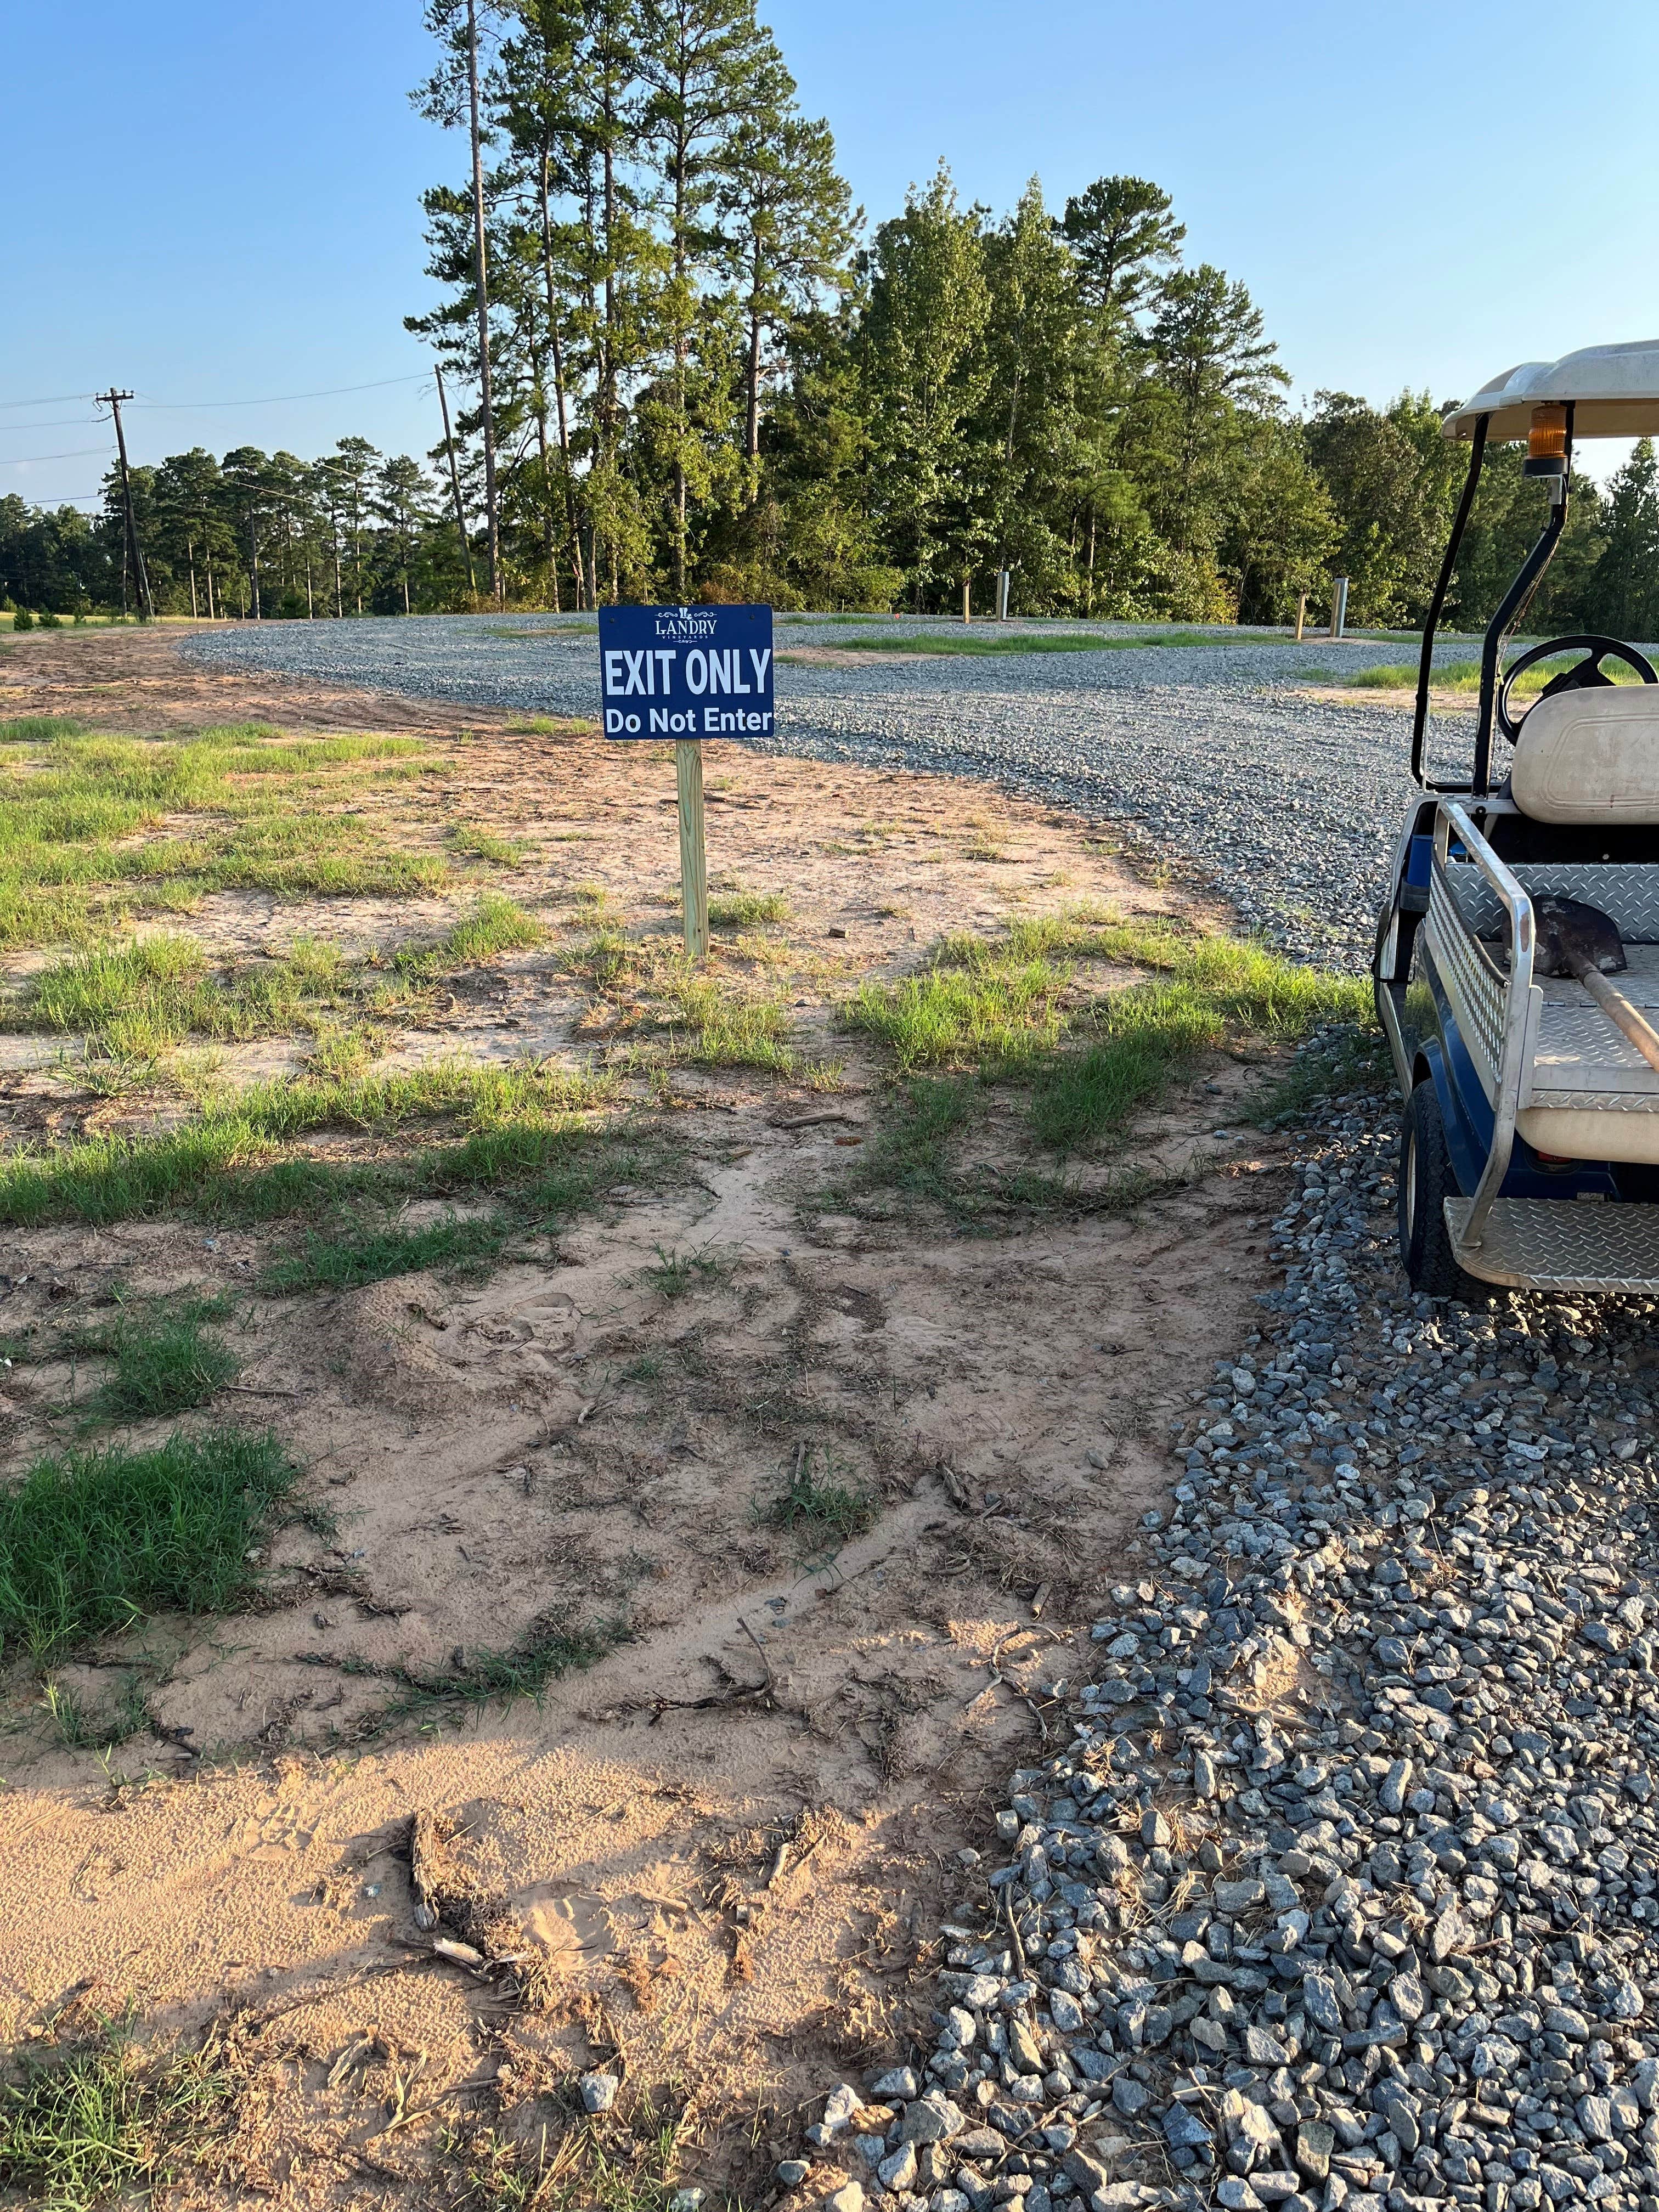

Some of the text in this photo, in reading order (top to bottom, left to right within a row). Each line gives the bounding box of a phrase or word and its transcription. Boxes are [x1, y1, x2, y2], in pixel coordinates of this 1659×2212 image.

[655, 620, 717, 635] LANDRY
[605, 649, 771, 695] EXIT ONLY
[606, 707, 772, 732] Do Not Enter
